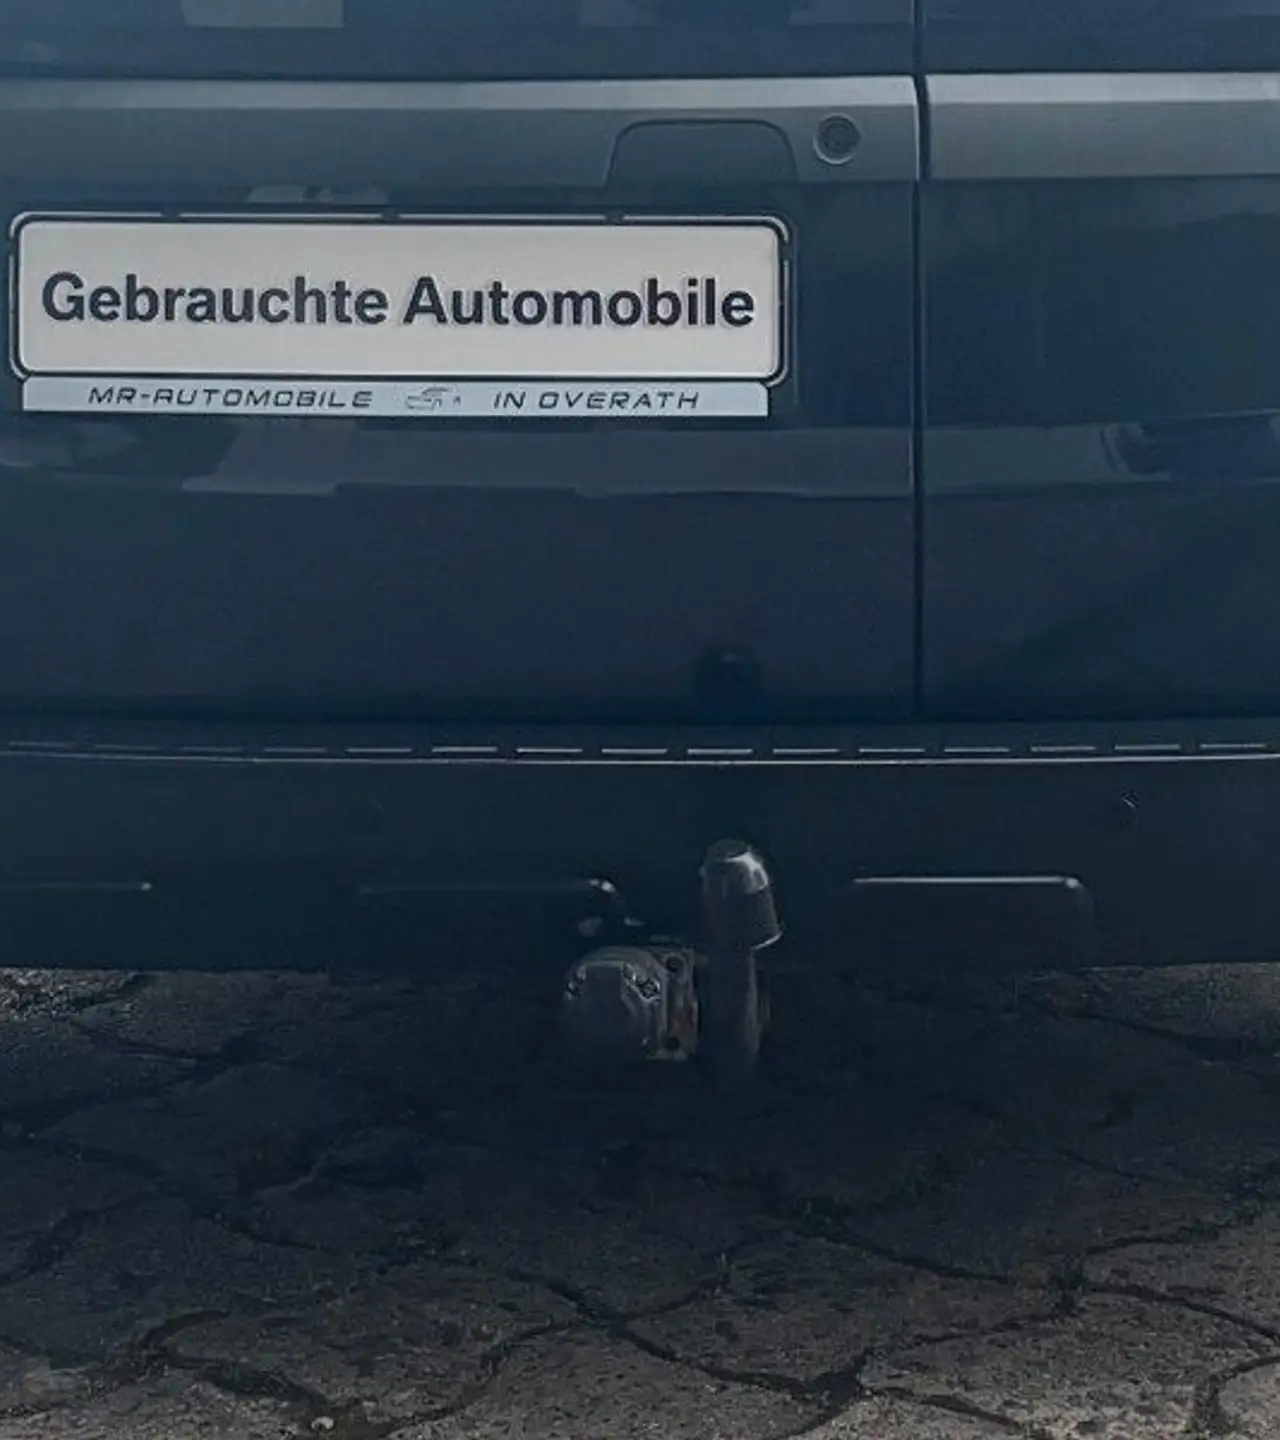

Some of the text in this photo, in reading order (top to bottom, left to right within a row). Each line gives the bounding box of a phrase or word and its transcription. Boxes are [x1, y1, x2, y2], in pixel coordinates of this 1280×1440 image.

[42, 271, 755, 327] Gebrauchte Automobile
[88, 387, 700, 411] MR-AUTOMOBILE IN OVERATH
